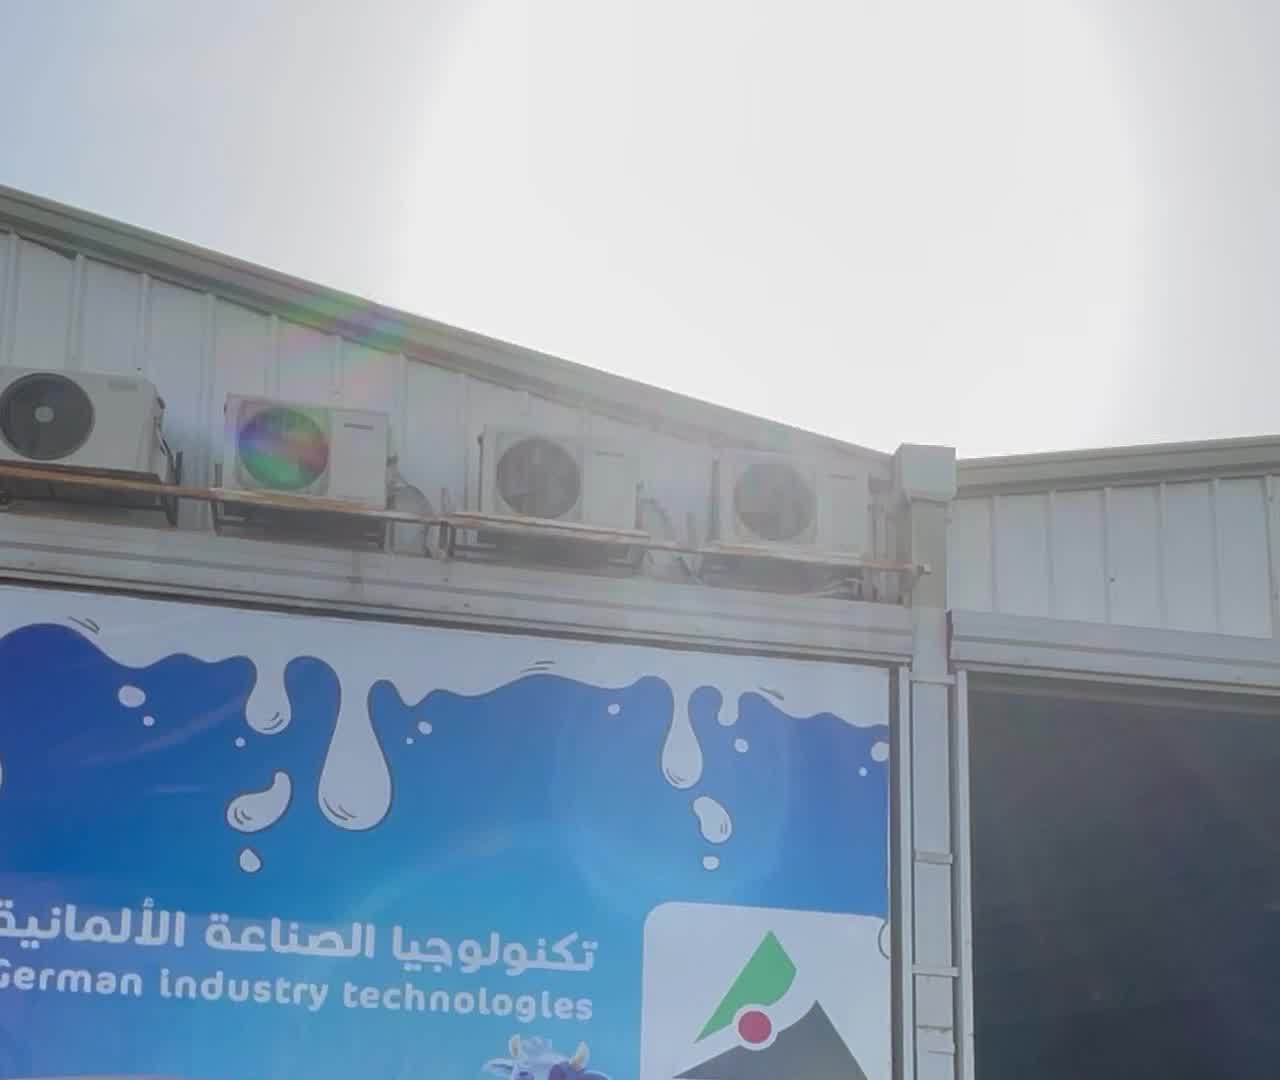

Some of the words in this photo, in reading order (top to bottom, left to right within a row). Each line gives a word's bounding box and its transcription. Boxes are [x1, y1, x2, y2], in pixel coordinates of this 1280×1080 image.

[205, 912, 376, 959] الصناعة
[392, 925, 599, 976] تكنولوجيا
[160, 968, 329, 1012] industry
[343, 981, 593, 1022] technologies
